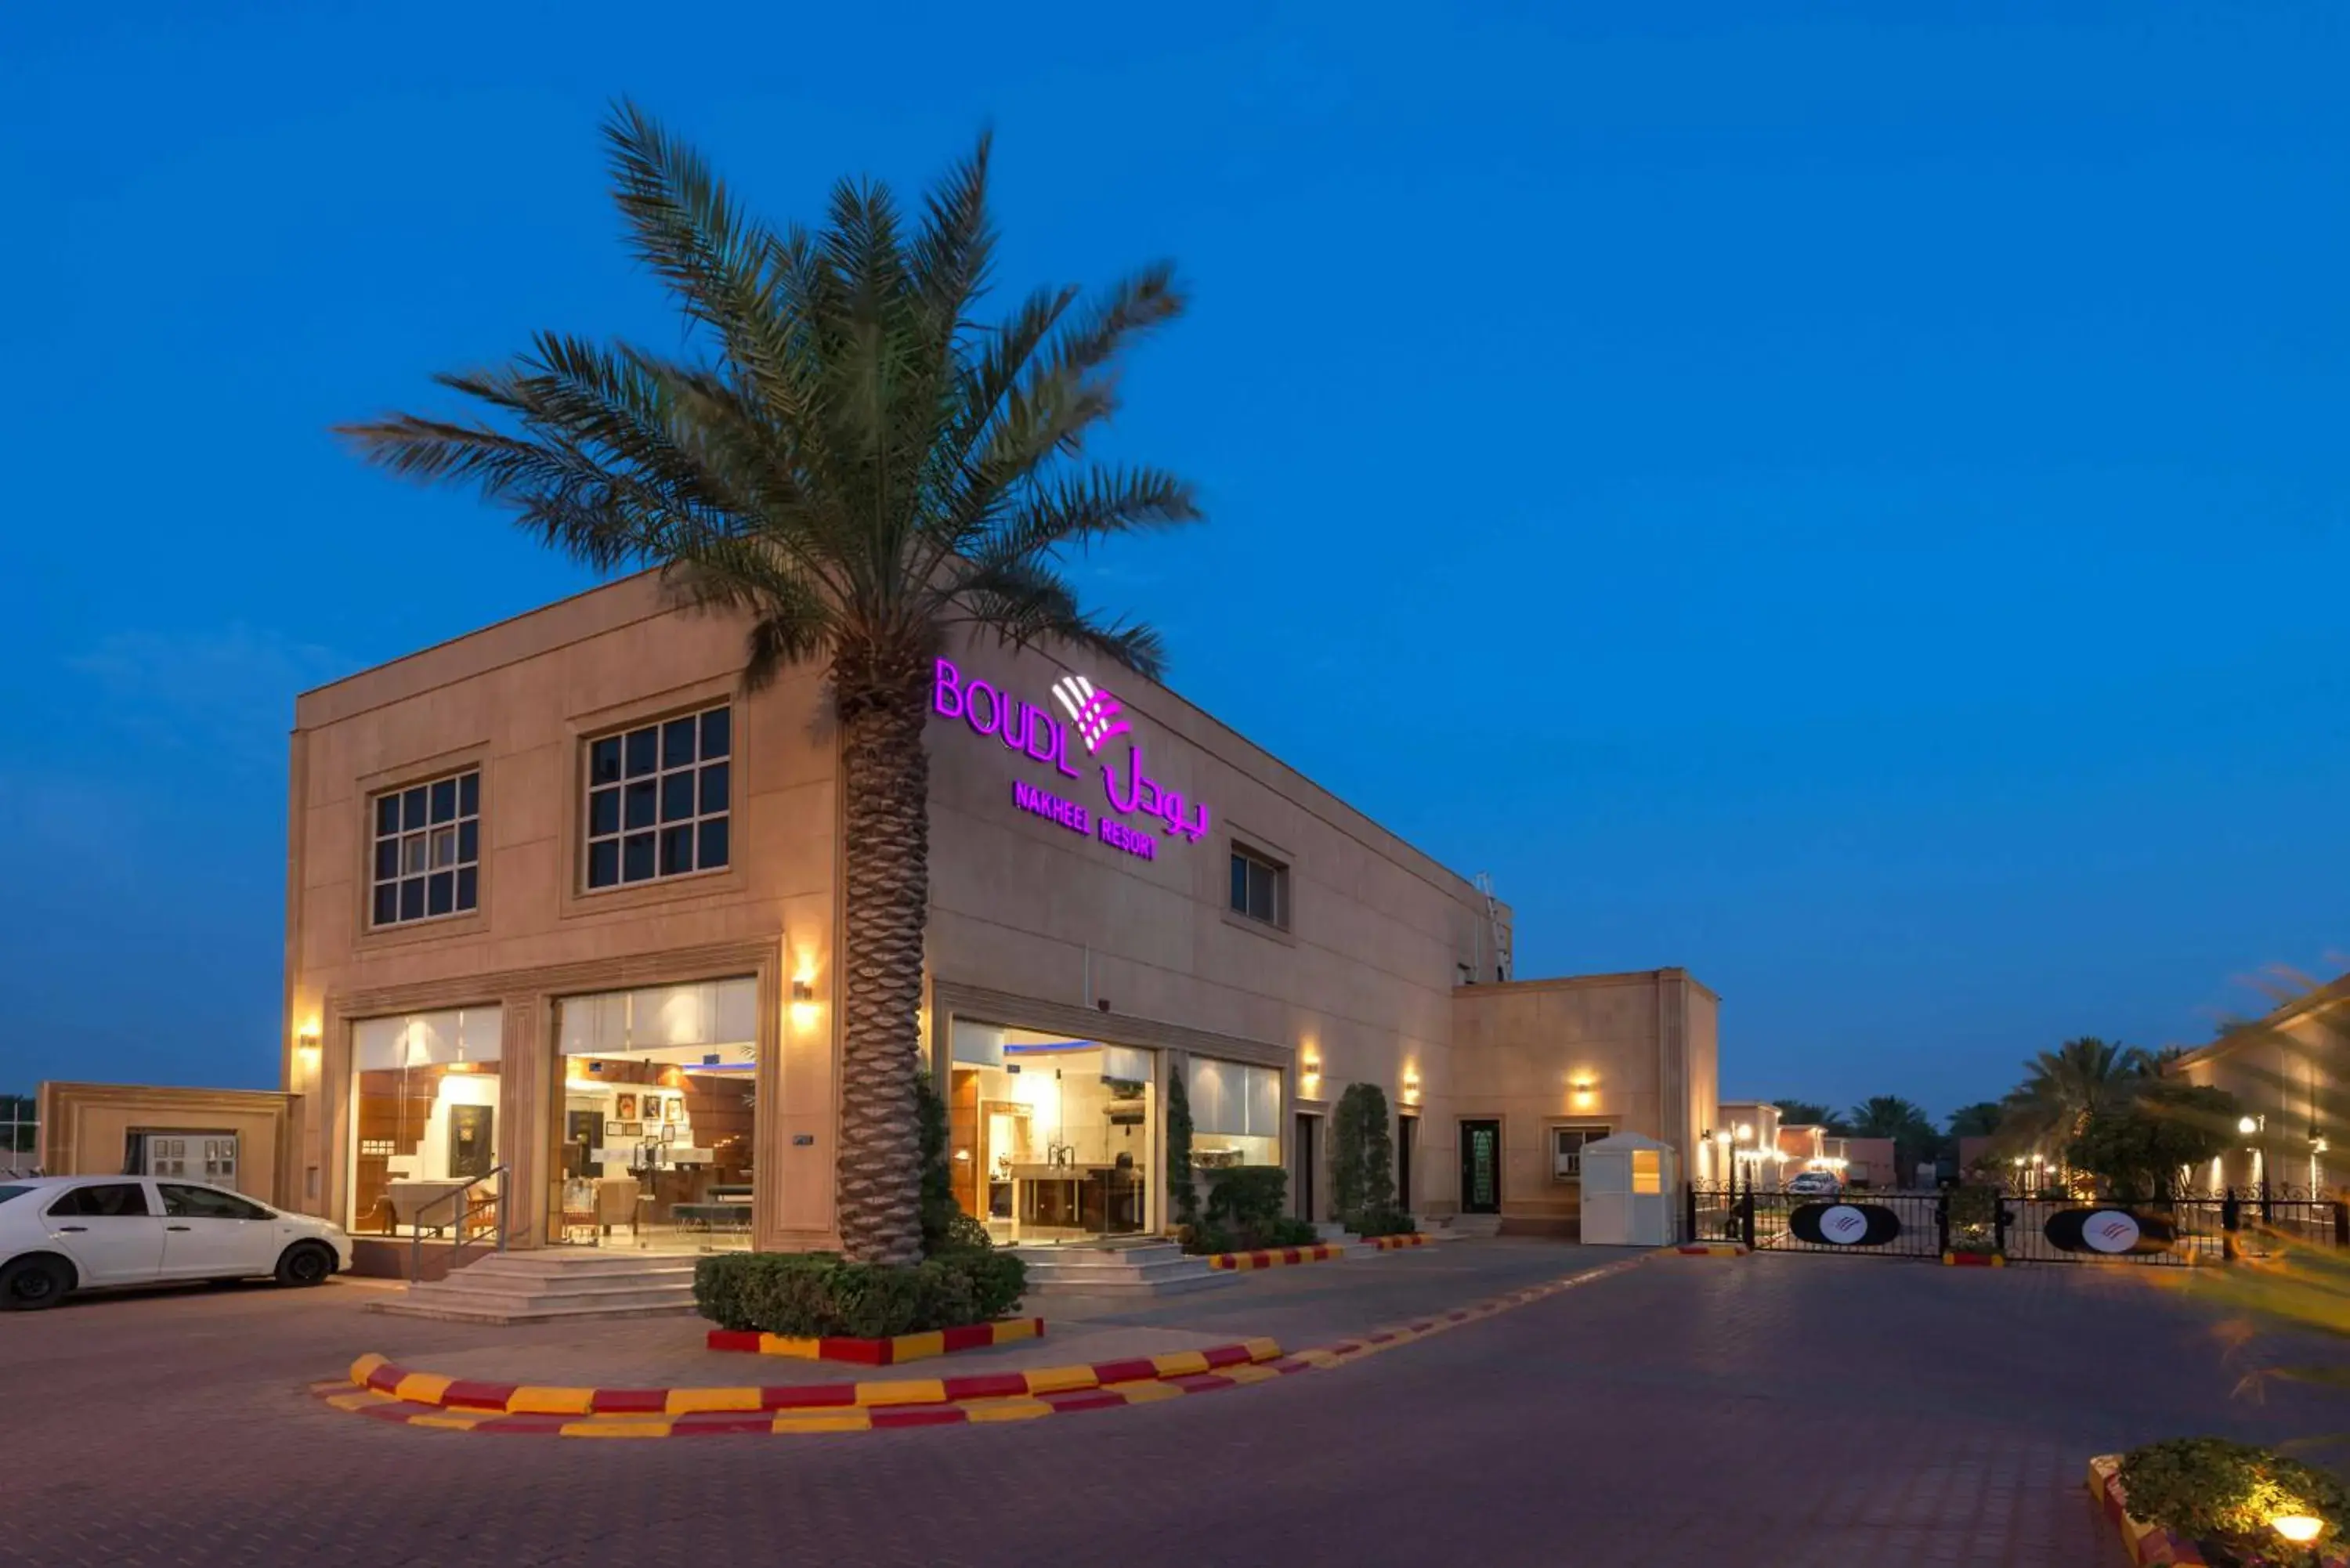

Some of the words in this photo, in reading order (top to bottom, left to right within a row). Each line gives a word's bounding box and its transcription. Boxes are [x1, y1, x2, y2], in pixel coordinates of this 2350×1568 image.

[933, 657, 1079, 779] BOUDL
[1013, 780, 1090, 836] NAKHEEL
[1098, 817, 1158, 861] RESORT
[1101, 745, 1207, 843] بودل
